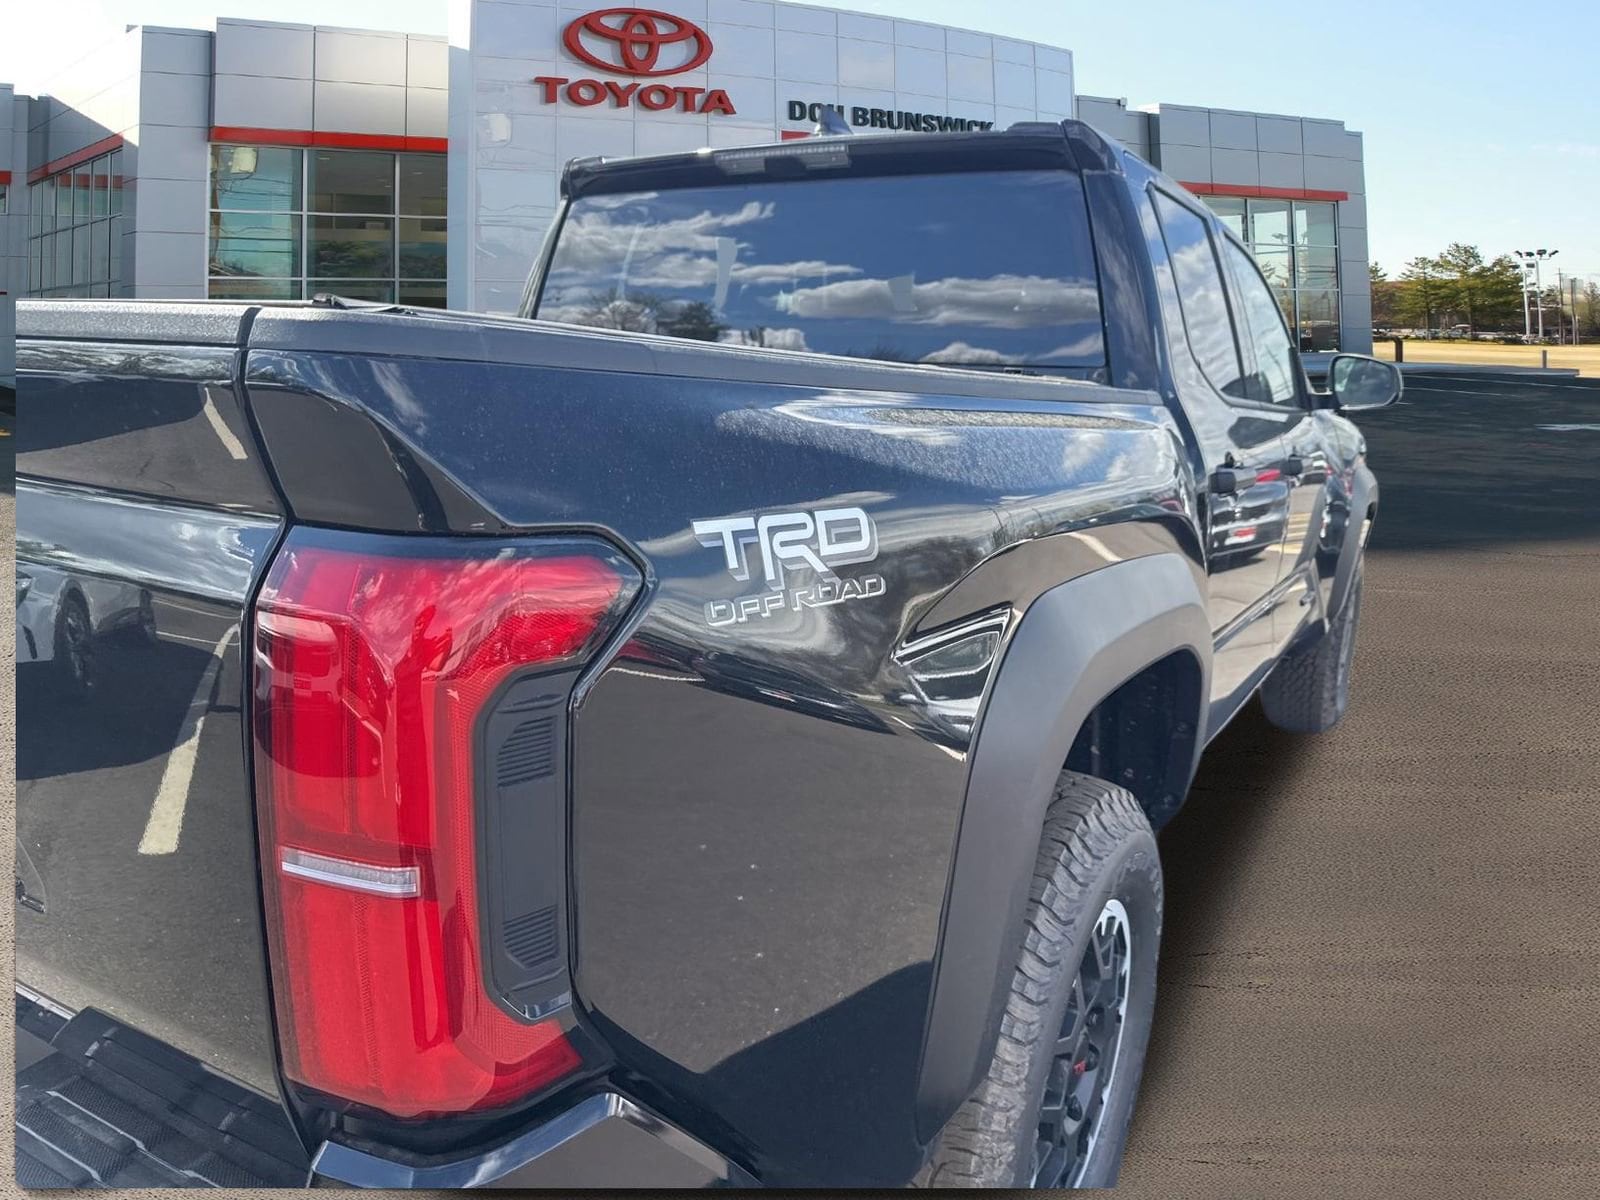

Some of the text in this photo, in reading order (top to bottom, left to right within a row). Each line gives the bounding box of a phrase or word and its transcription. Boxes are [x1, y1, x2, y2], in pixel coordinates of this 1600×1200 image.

[534, 76, 736, 115] TOYOTA
[852, 106, 994, 132] BRUNSWICK
[692, 507, 879, 591] TRD
[703, 573, 887, 627] OFF ROAD
